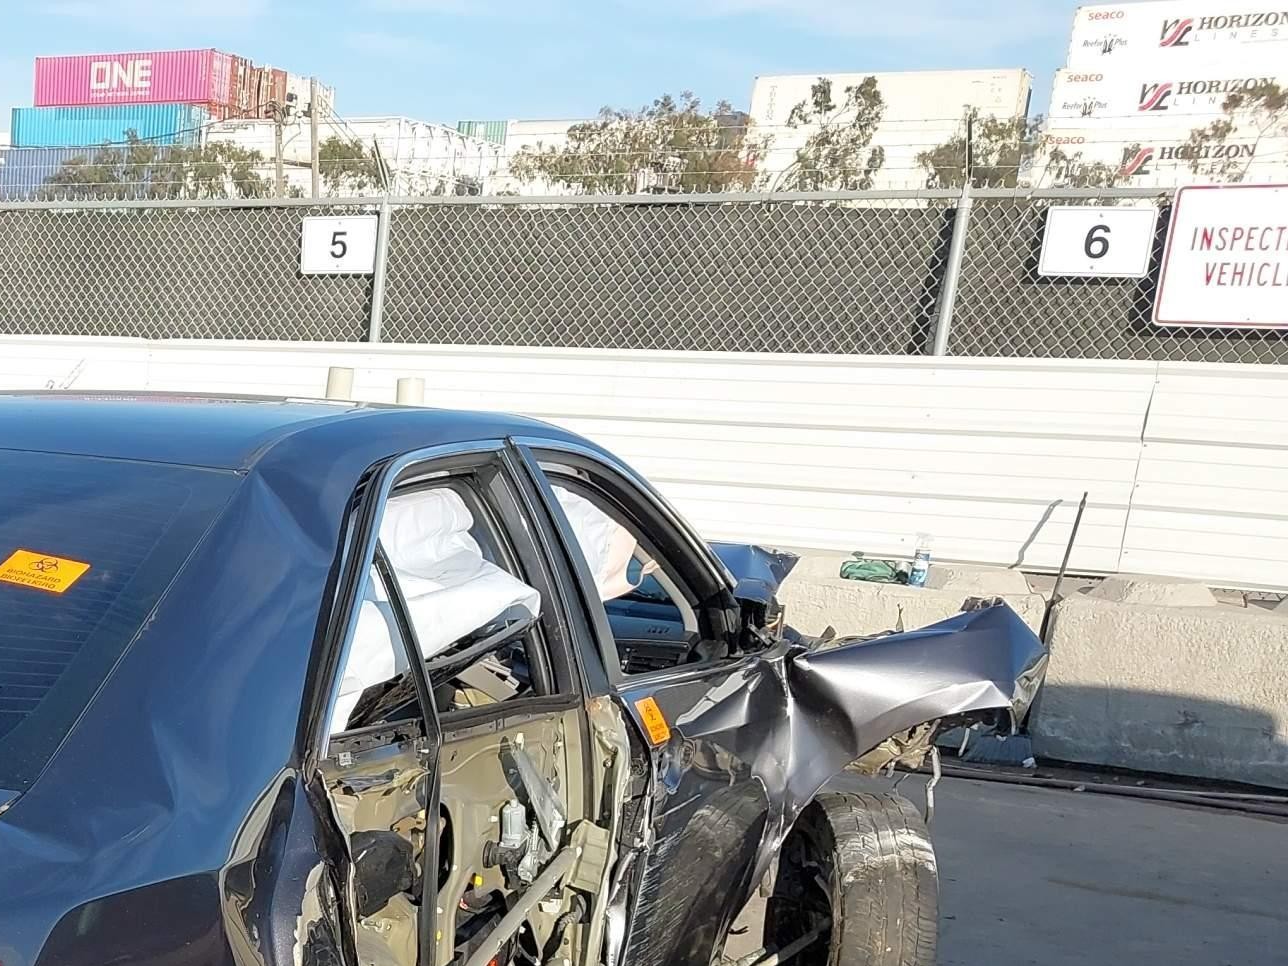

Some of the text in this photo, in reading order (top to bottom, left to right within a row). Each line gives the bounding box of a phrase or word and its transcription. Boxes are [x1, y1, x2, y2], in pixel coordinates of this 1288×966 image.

[1088, 10, 1125, 21] seaco
[90, 59, 152, 90] ONE
[1066, 73, 1104, 83] seaco
[1048, 135, 1085, 145] seaco
[330, 231, 347, 259] 5
[1083, 224, 1111, 259] 6
[1191, 226, 1288, 252] INSPECT
[1205, 261, 1288, 287] VEHICL
[6, 568, 62, 584] BIOHAZARD
